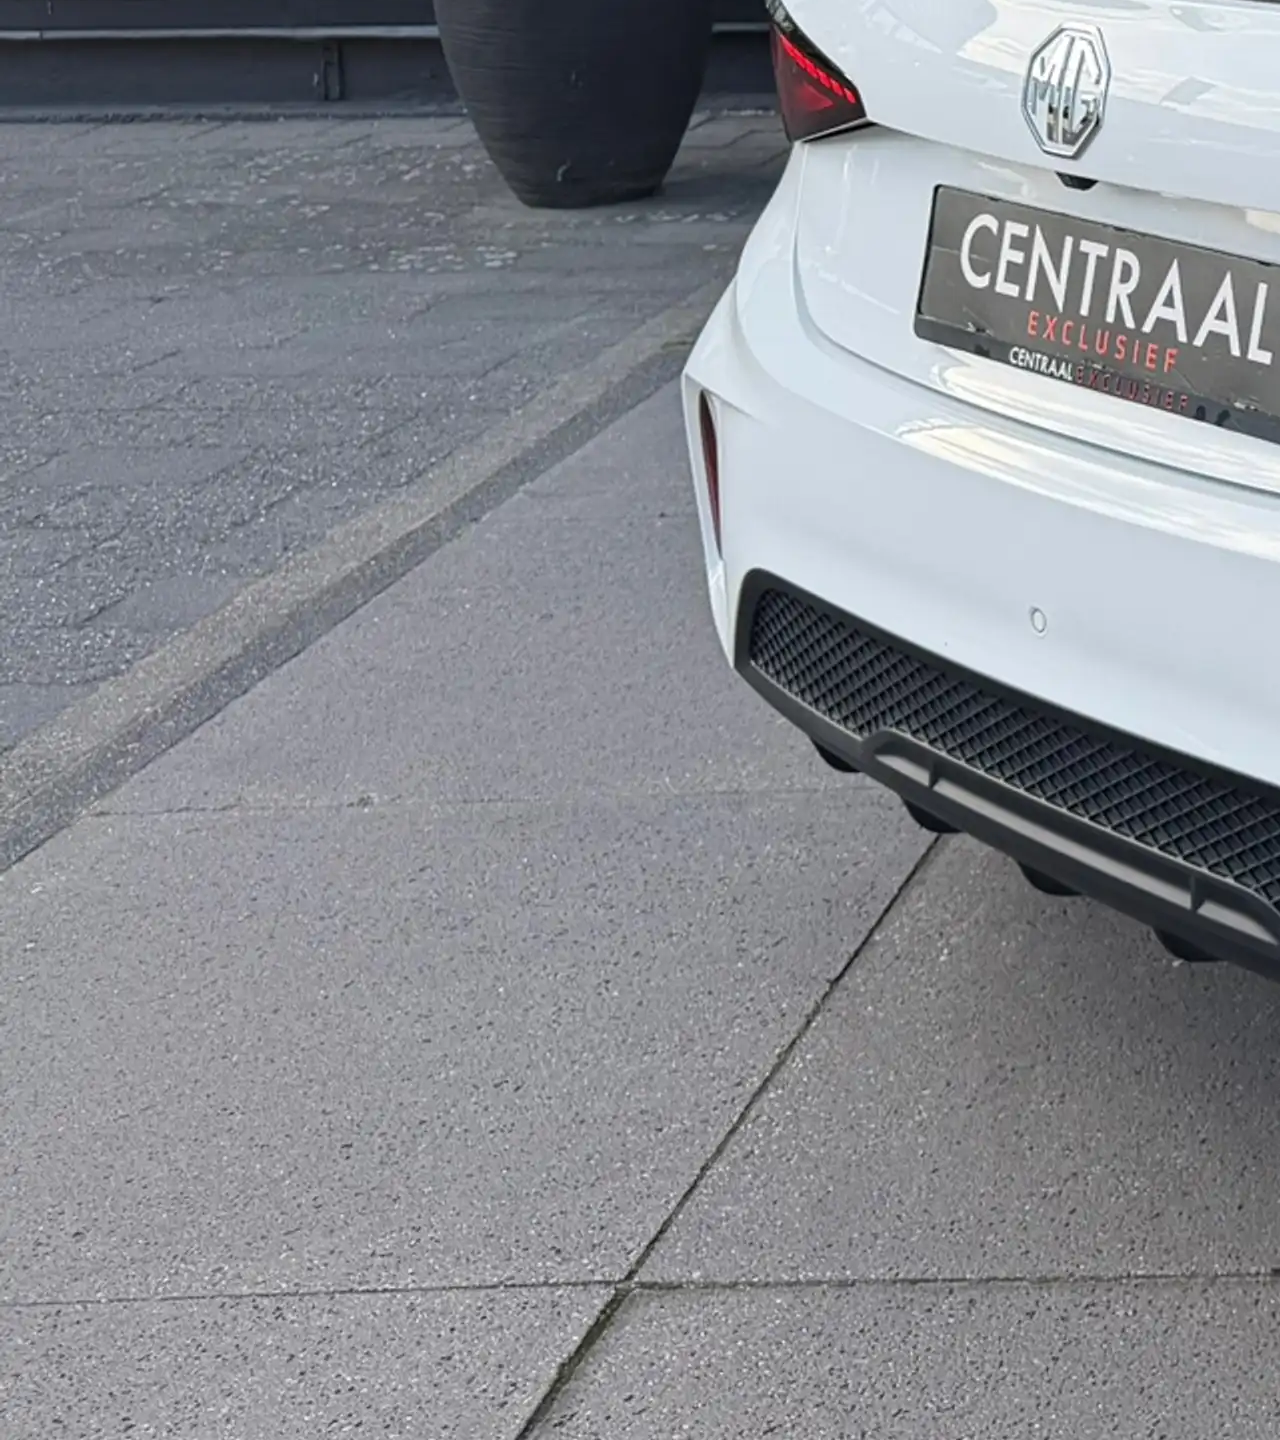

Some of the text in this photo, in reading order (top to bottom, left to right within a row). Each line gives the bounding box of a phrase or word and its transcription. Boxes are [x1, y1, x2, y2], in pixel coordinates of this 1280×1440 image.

[1027, 32, 1103, 146] MG
[959, 213, 1274, 365] CENTRAAL
[1008, 345, 1189, 410] CENTRAAL EXCLUSIEF
[1026, 310, 1179, 373] EXCLUSIEF
